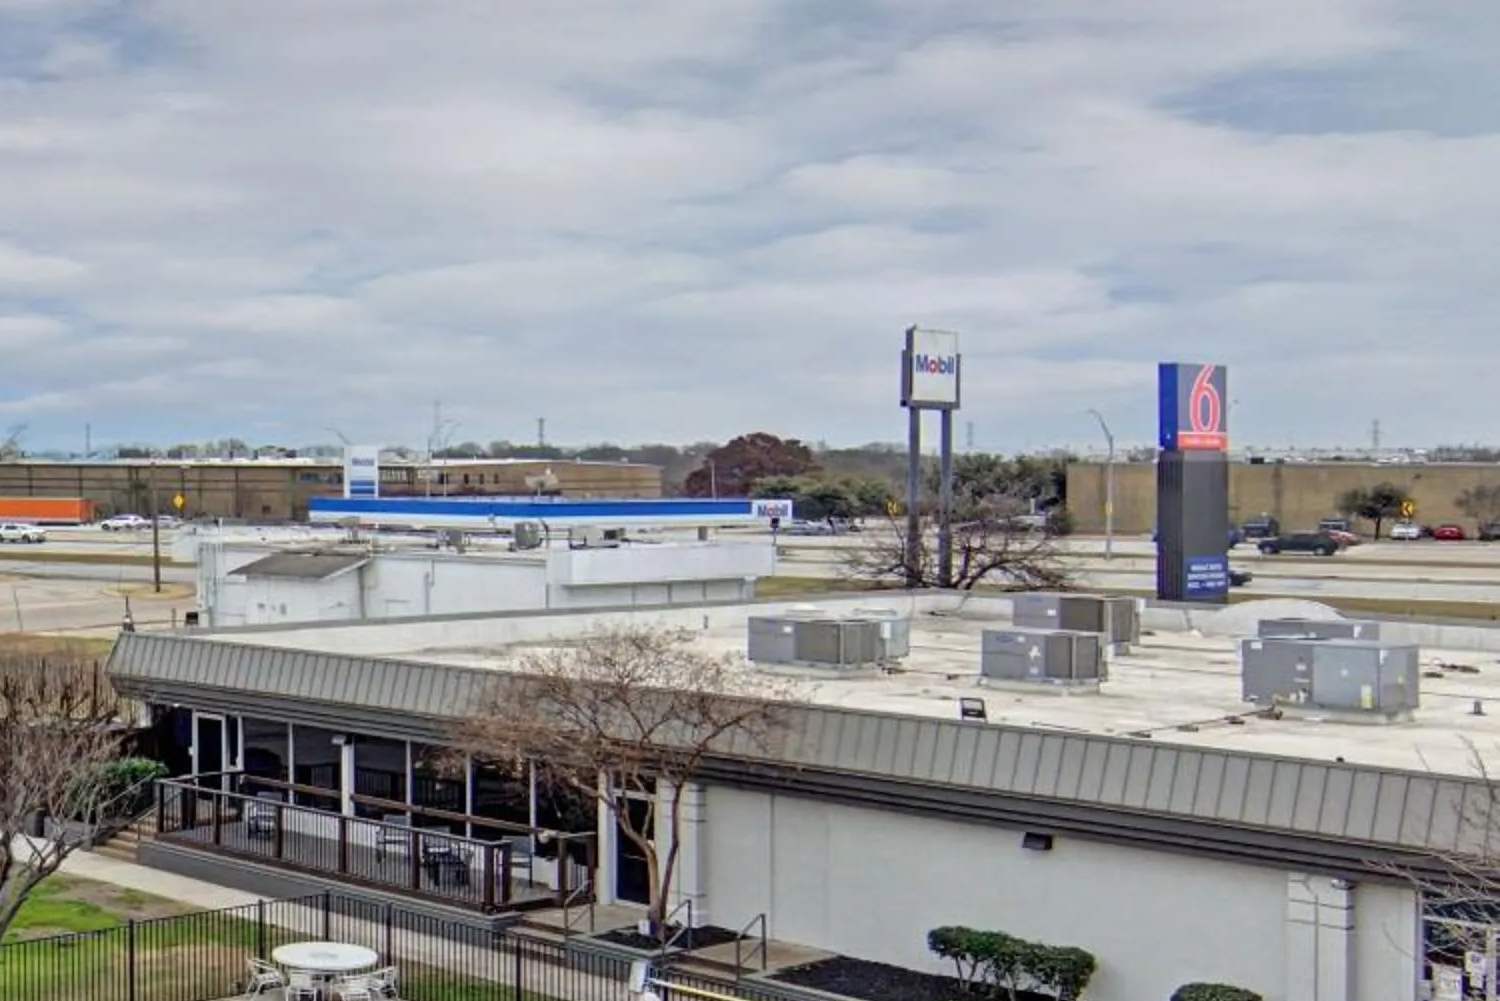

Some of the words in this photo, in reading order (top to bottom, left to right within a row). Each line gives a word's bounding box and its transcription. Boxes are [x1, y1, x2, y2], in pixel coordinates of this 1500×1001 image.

[915, 354, 955, 374] Mobil
[1189, 364, 1221, 433] 6
[757, 503, 789, 517] Mobil
